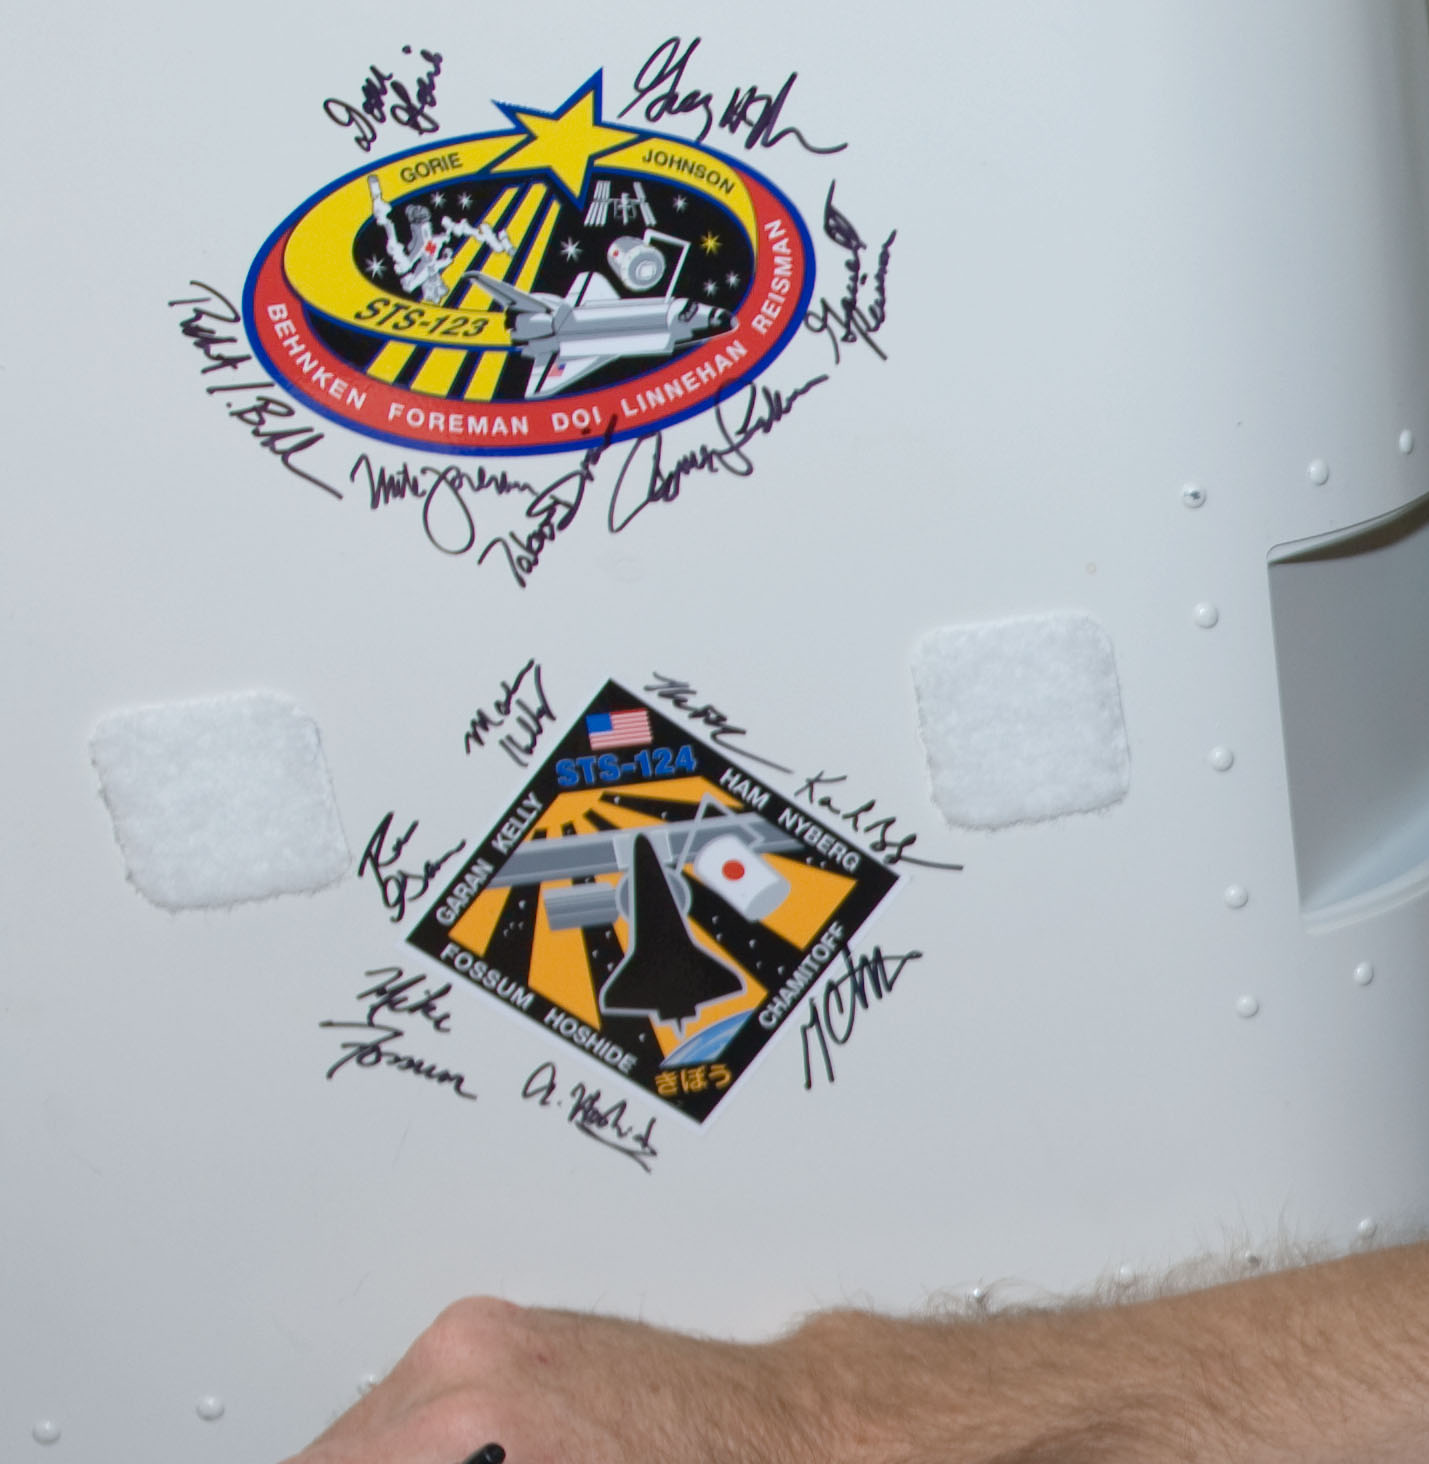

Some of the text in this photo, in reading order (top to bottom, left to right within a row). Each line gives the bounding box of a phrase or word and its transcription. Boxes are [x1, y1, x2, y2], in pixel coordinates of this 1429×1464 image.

[400, 152, 464, 184] GORIE
[642, 149, 736, 195] JOHNSON
[267, 219, 793, 437] BEHNKEN FOREMAN DOI LINNEHAN REISMAN
[354, 298, 489, 338] STS-123
[555, 744, 697, 787] STS-124
[719, 768, 771, 811] HAM
[777, 807, 862, 873] NYBERG
[435, 857, 494, 926] GARAN
[491, 792, 544, 855] KELLY
[440, 943, 639, 1075] FOSSUM HOSHIDE
[758, 920, 845, 1030] CHAMITOFF
[655, 1063, 733, 1097] きぼう
